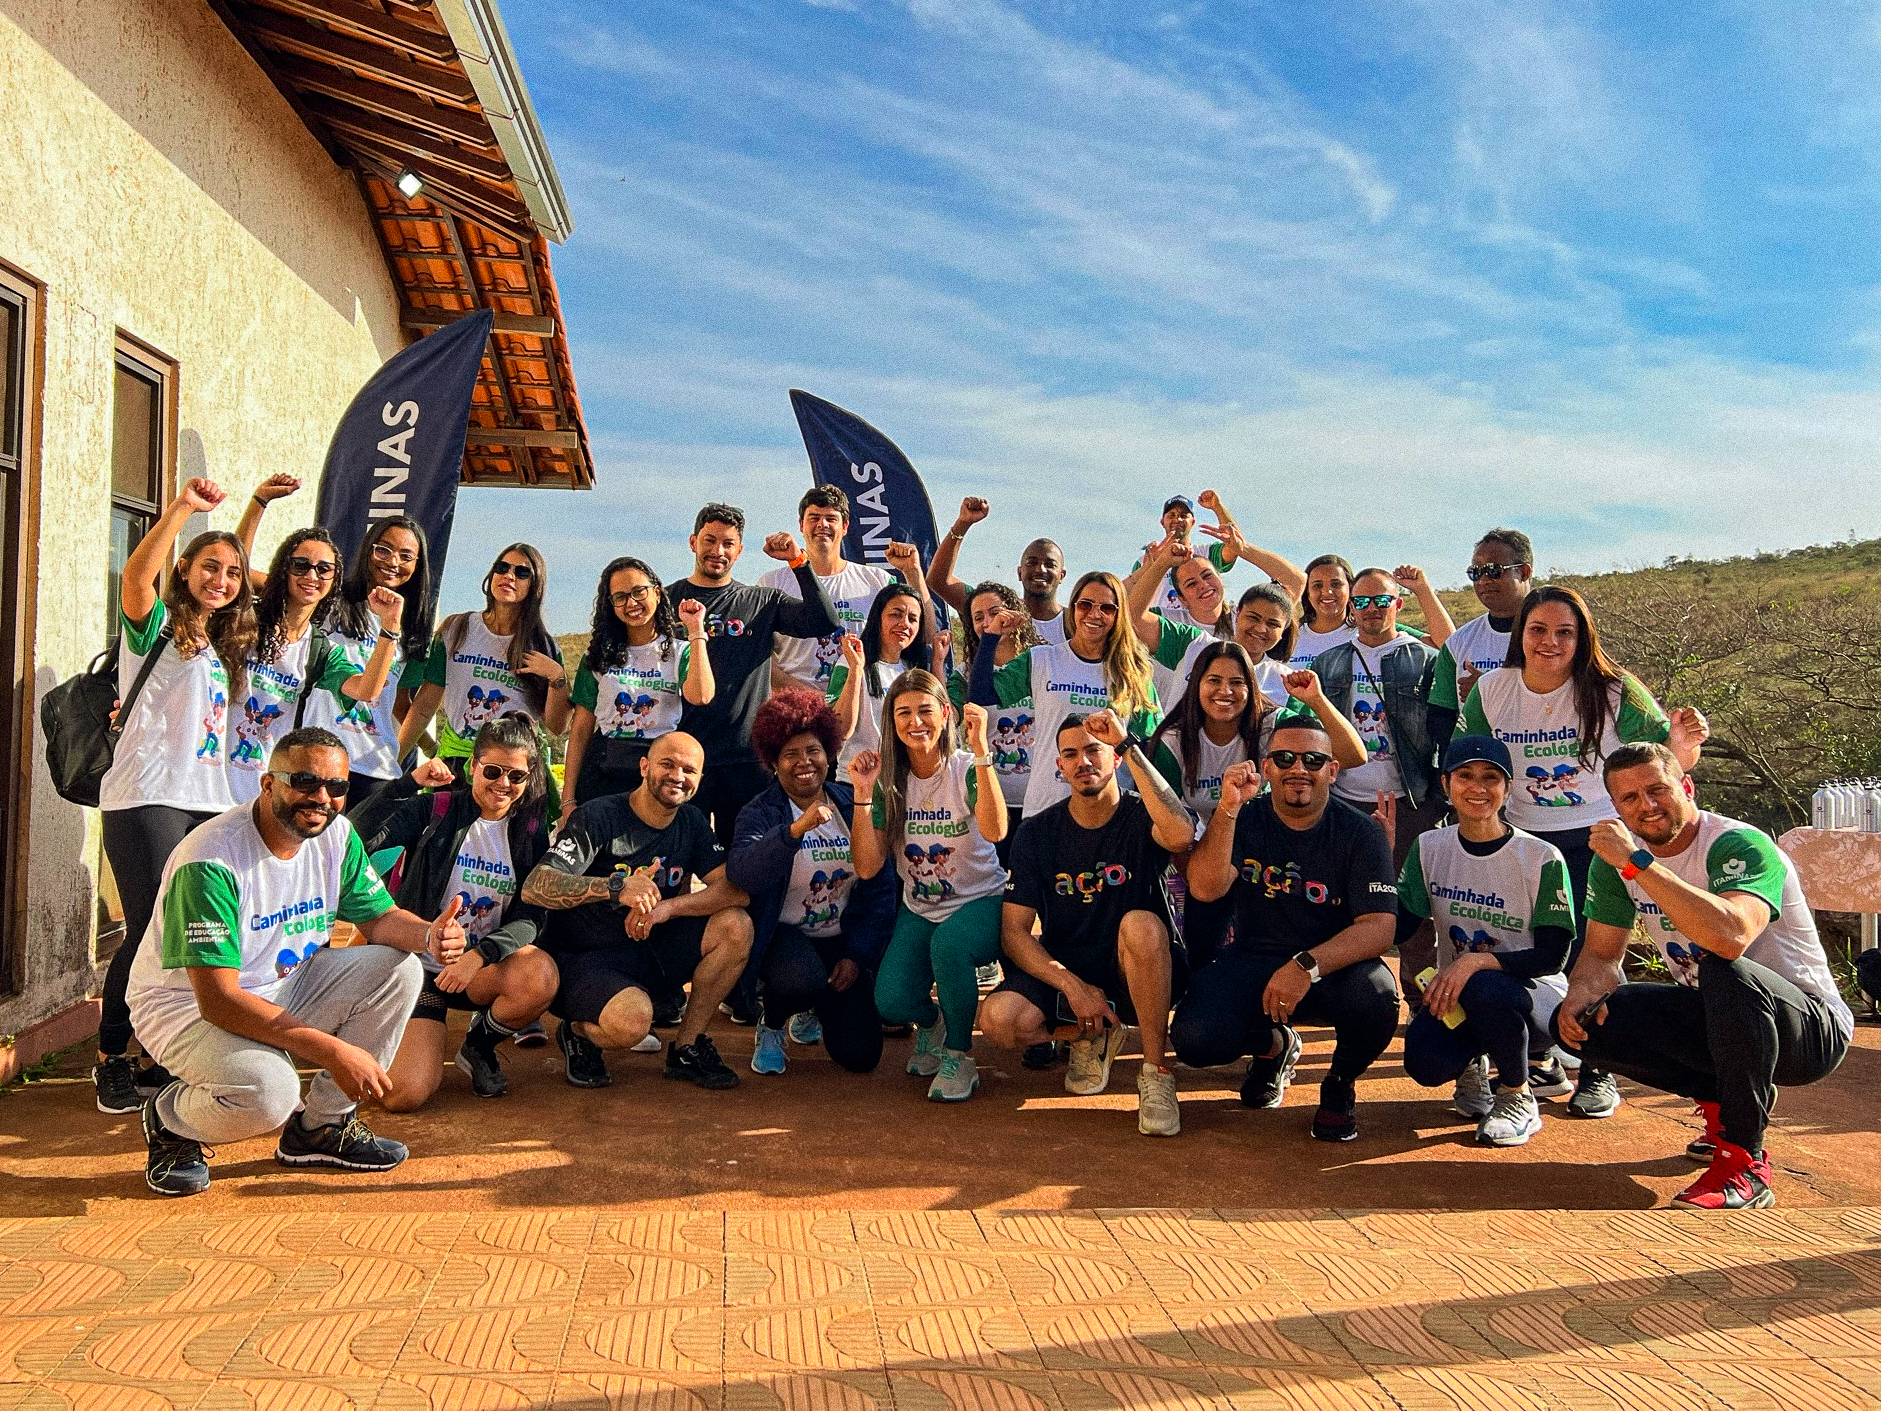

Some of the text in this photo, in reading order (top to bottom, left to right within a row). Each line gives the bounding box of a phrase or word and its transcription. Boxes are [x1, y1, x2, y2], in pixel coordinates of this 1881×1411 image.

[364, 400, 419, 532] INAS
[850, 461, 895, 570] INAS
[1046, 680, 1107, 696] Caminhad
[1495, 726, 1577, 743] Caminhada
[905, 807, 951, 820] inhada
[907, 820, 970, 838] Ecológica
[800, 835, 849, 850] minhada
[456, 853, 510, 875] minhada
[812, 848, 854, 863] Ecológ
[462, 868, 516, 894] Ecológic
[1430, 881, 1505, 909] Caminhada
[1449, 901, 1524, 929] Ecológica
